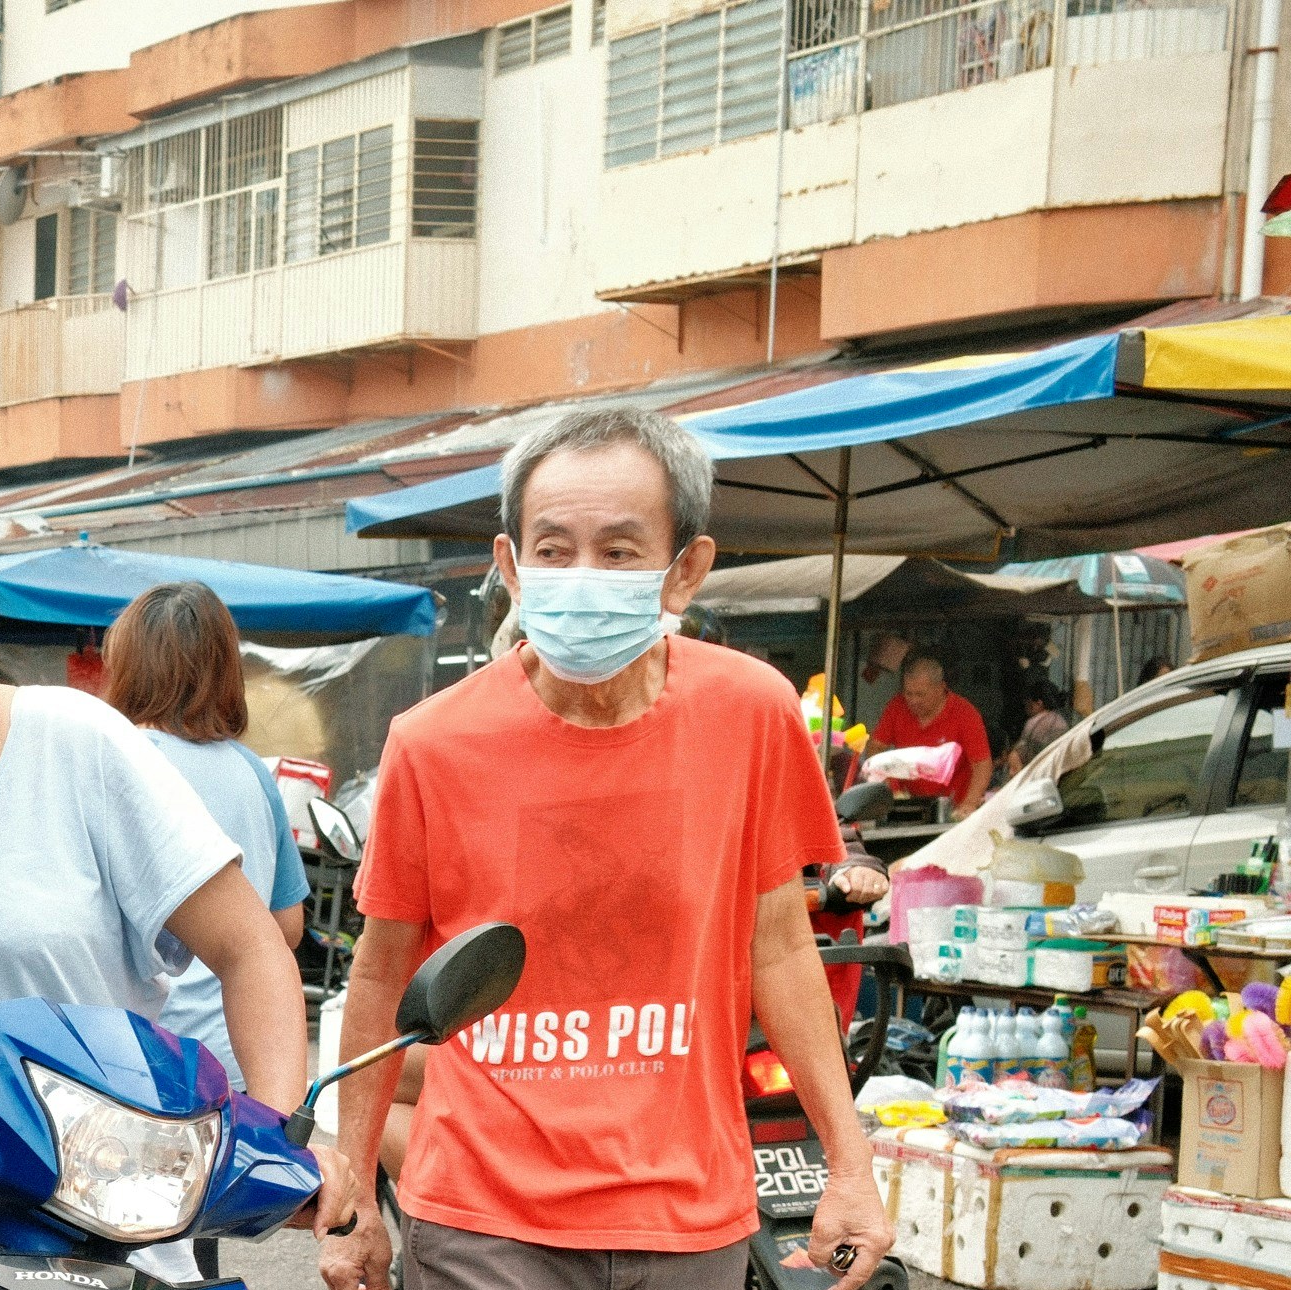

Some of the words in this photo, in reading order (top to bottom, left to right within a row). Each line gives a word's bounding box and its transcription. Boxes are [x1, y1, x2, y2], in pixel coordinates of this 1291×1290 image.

[457, 1009, 590, 1065] WISS
[607, 998, 696, 1059] POL
[490, 1066, 546, 1082] SPORT
[550, 1067, 563, 1080] &
[569, 1065, 615, 1079] POLO
[618, 1061, 665, 1077] CLUB
[754, 1146, 822, 1173] PQL
[14, 1271, 109, 1290] HONDA
